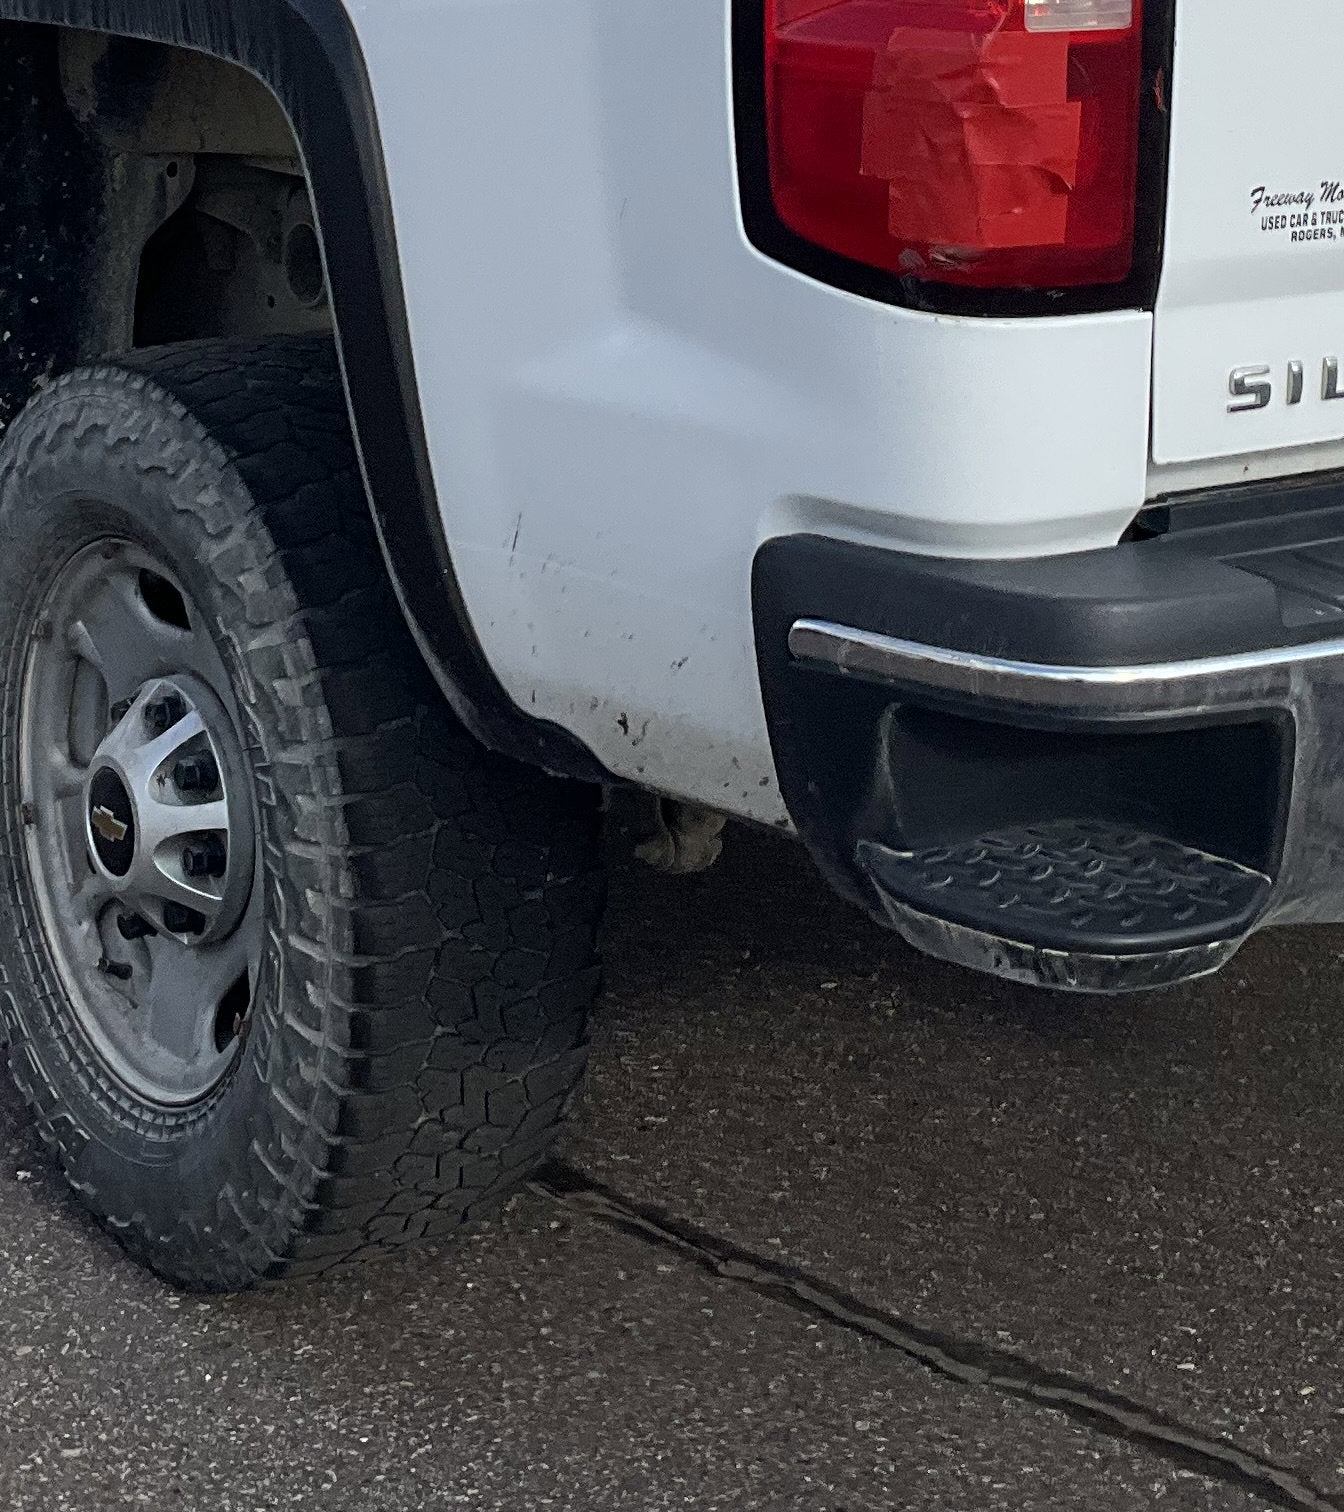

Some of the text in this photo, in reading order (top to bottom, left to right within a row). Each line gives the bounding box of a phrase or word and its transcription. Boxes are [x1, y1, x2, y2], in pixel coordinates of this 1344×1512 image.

[1251, 186, 1314, 214] Freeway
[1261, 215, 1286, 230] USED
[1289, 213, 1308, 227] CAR
[1311, 212, 1317, 226] &
[1291, 227, 1337, 242] ROGERS,
